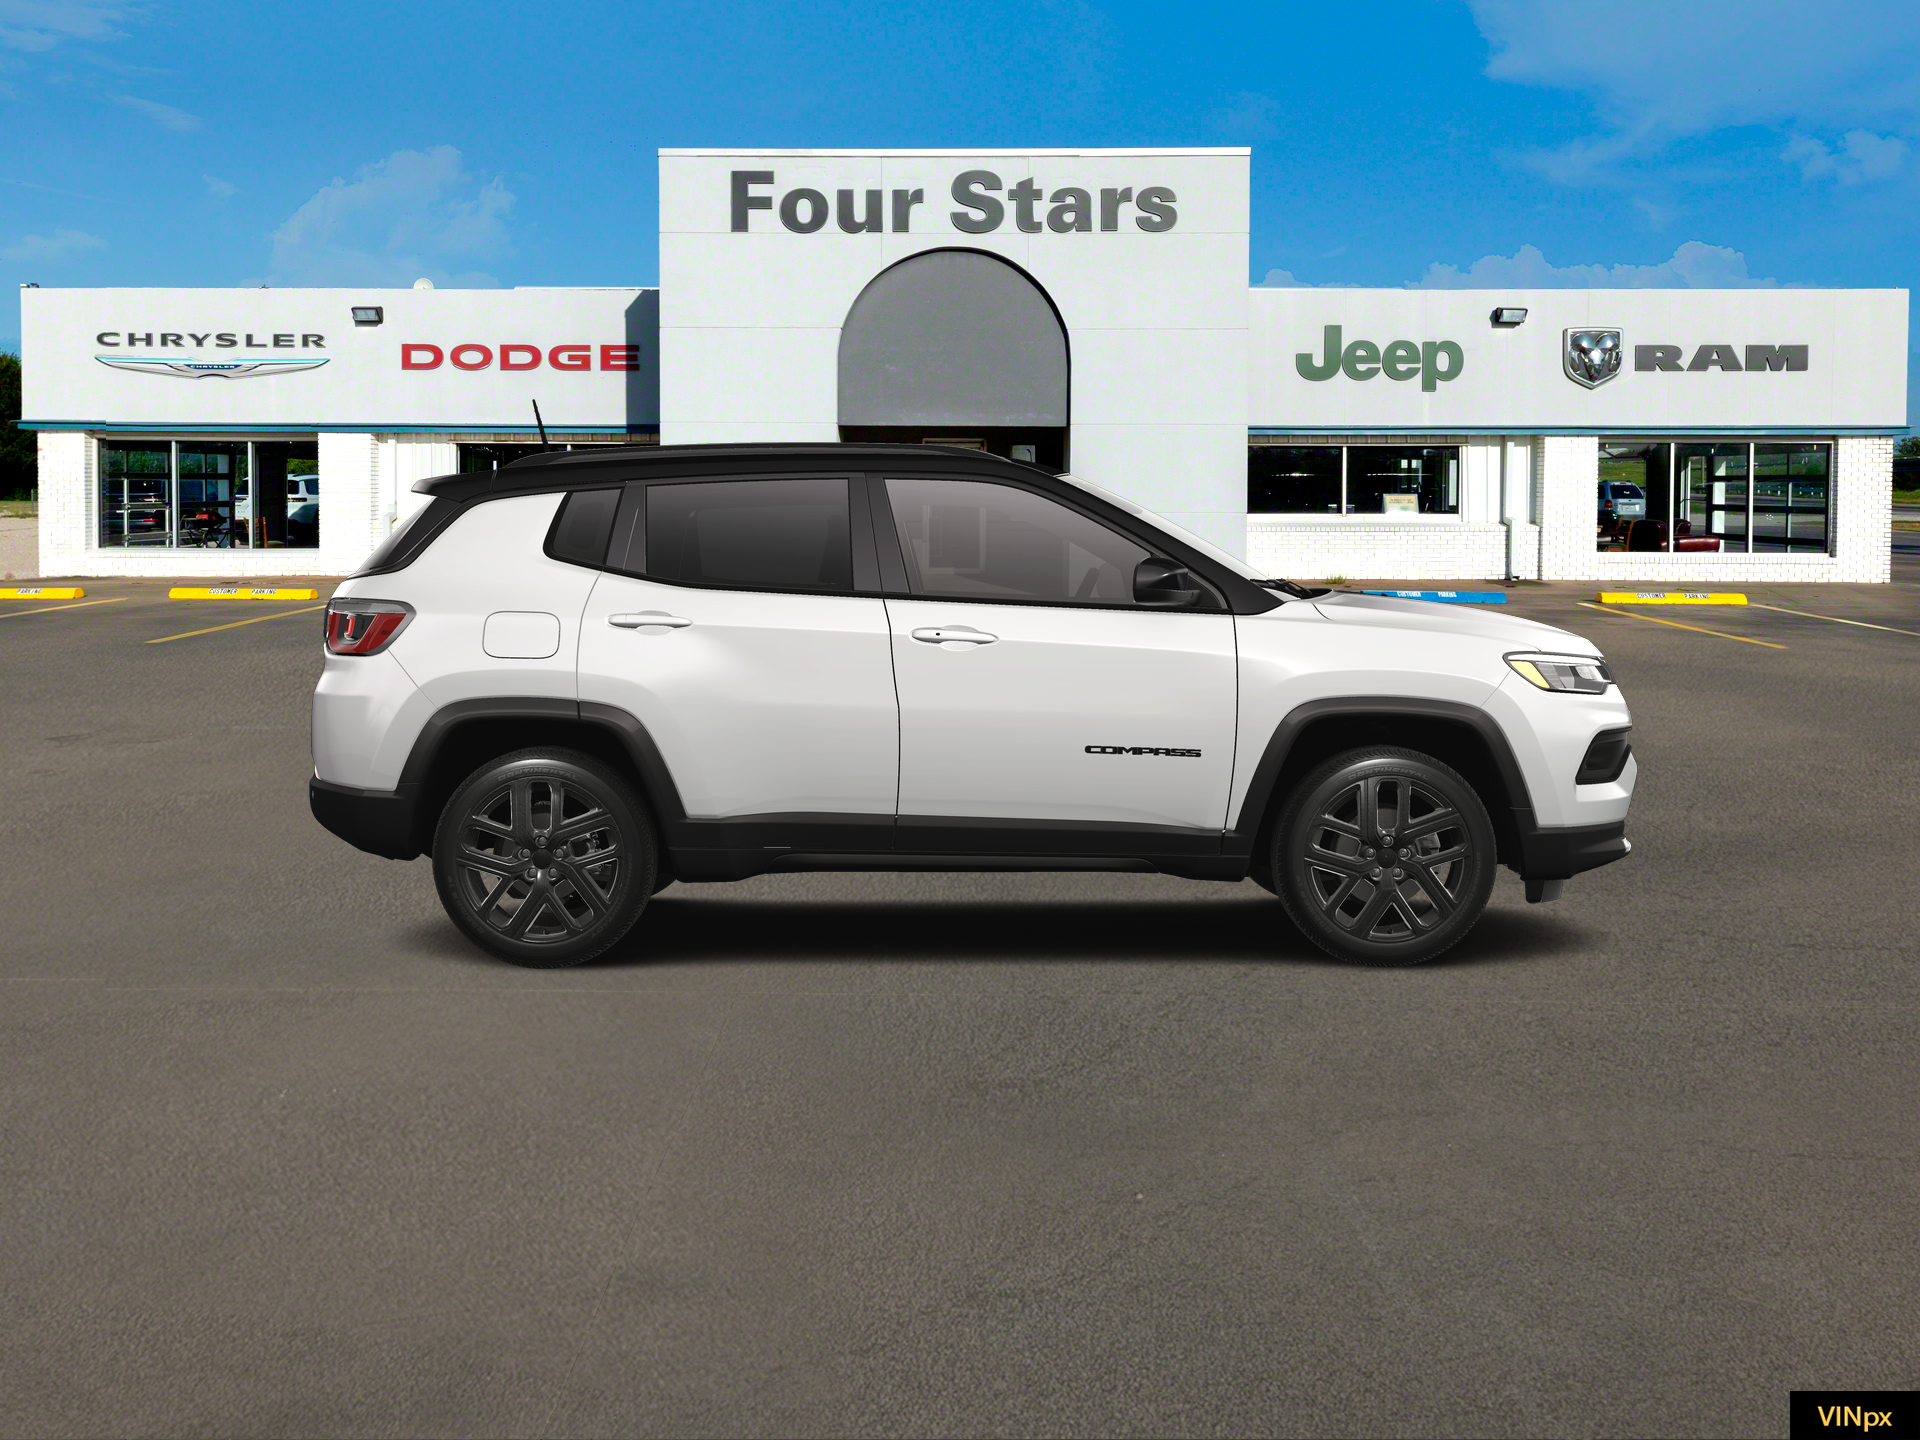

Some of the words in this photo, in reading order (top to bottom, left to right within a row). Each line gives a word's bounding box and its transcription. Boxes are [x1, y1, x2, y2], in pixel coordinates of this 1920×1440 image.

[729, 169, 925, 234] Four
[949, 169, 1178, 234] Stars
[96, 332, 327, 349] CHRYSLER
[401, 343, 640, 371] DODGE
[1295, 324, 1465, 393] Jeep
[1634, 344, 1809, 372] RAM
[208, 587, 239, 595] CUSTOMER
[1084, 745, 1202, 757] COMPASS
[498, 767, 580, 782] CONTINENTAL
[1348, 766, 1429, 781] CONTINENTAL
